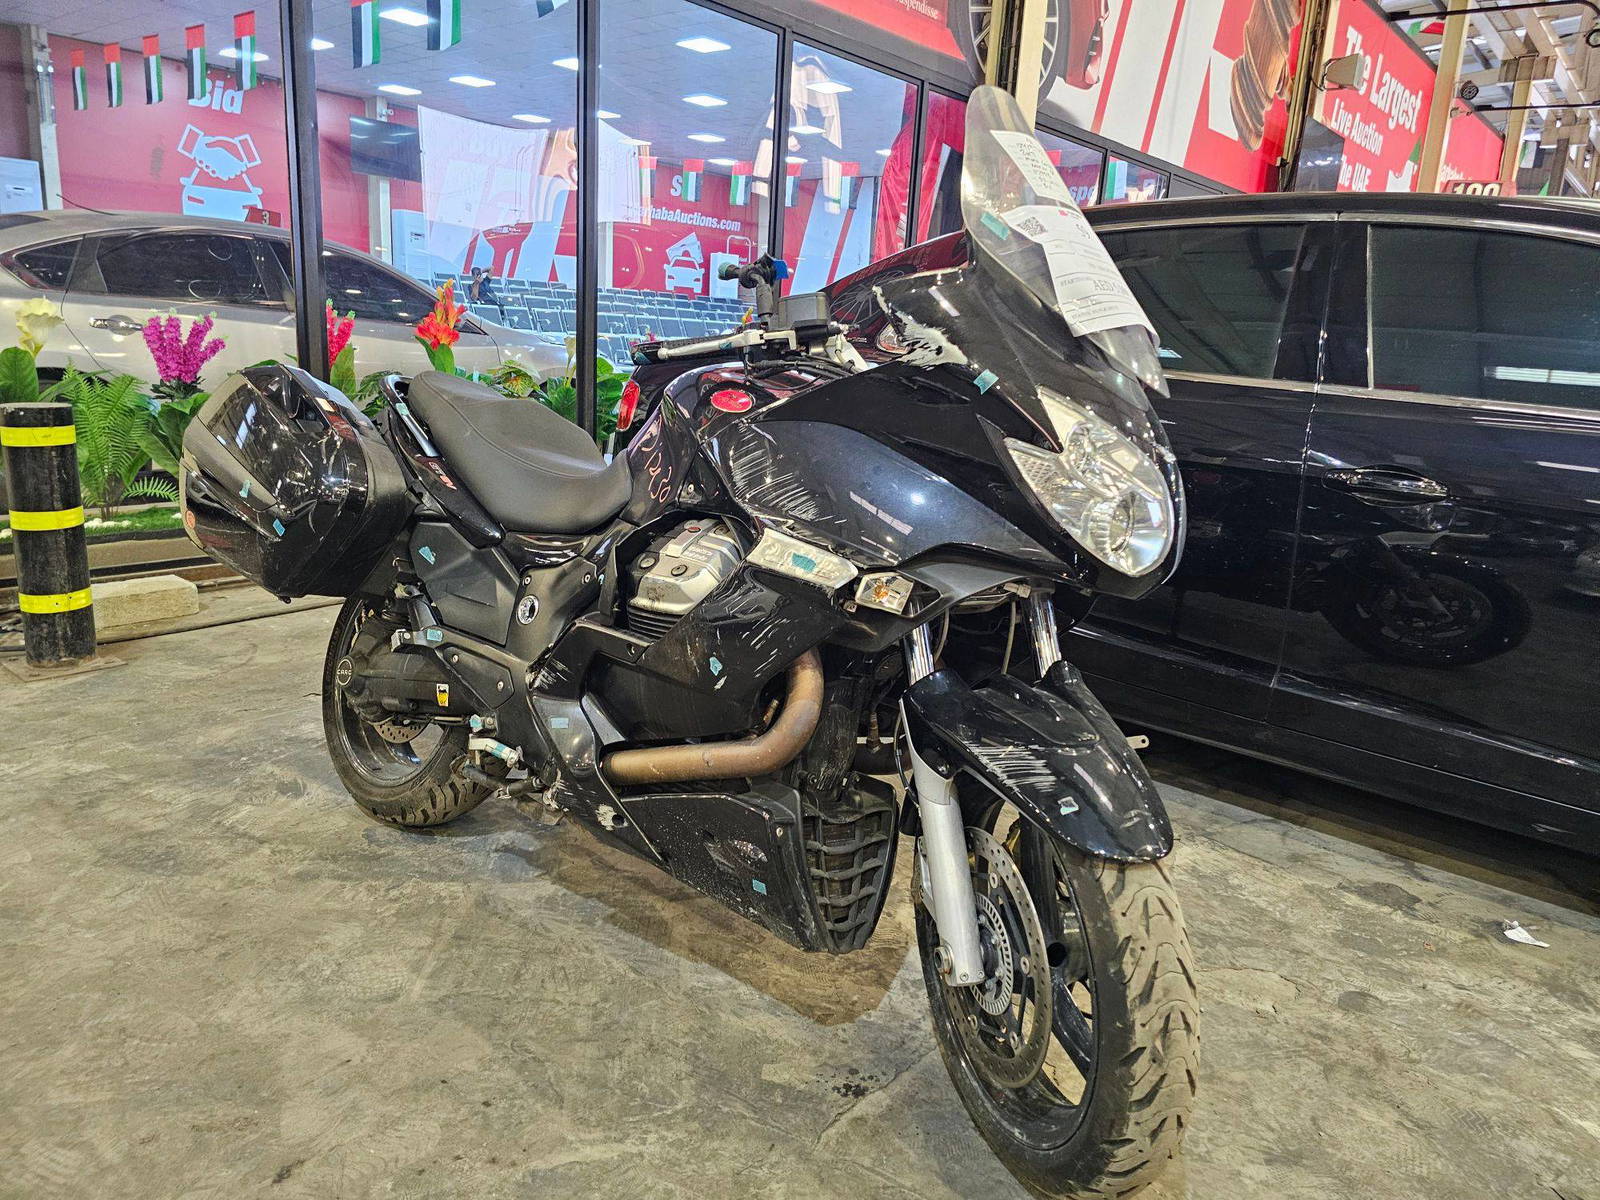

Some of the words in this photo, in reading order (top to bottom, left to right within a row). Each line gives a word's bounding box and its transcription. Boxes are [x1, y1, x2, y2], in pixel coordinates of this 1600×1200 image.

[1369, 53, 1423, 134] Largest
[1330, 98, 1352, 134] Live
[1350, 112, 1384, 156] Auction
[1352, 162, 1371, 193] UAE
